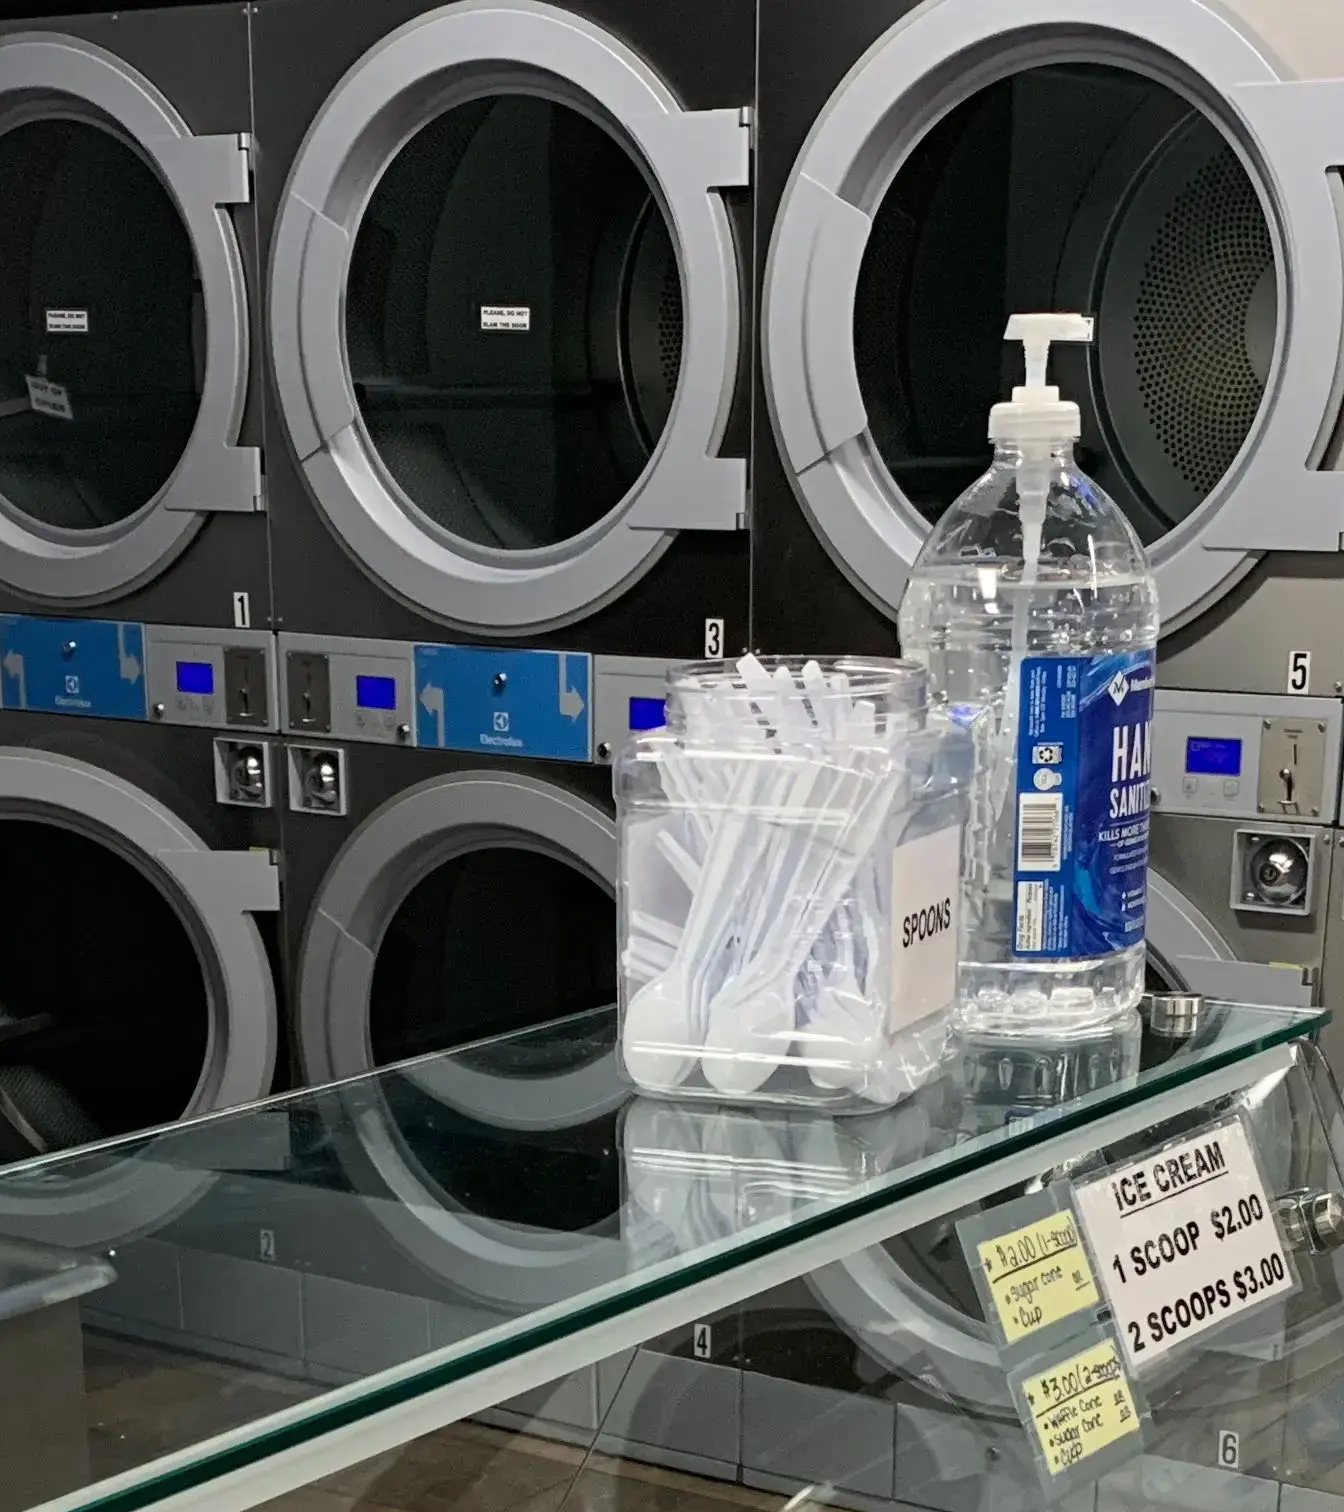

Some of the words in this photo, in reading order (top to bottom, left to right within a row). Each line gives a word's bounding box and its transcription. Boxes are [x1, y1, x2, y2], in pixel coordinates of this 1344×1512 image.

[237, 595, 247, 626] 1
[707, 621, 720, 657] 3
[1290, 652, 1308, 691] 5
[479, 733, 524, 748] Electrolux
[1112, 720, 1152, 783] HAN
[902, 898, 952, 949] SPOONS
[1111, 1170, 1152, 1211] ICE
[1152, 1140, 1226, 1193] CREAM
[262, 1231, 273, 1259] 2
[1113, 1254, 1127, 1284] 1
[1130, 1220, 1201, 1276] SCOOP
[1210, 1193, 1264, 1242] $2.00
[1009, 1276, 1040, 1305] sugar
[1127, 1321, 1146, 1354] 2
[1146, 1278, 1232, 1343] SCOOPS
[1232, 1252, 1285, 1302] $3.00
[696, 1326, 708, 1356] 4
[1222, 1433, 1237, 1465] 6
